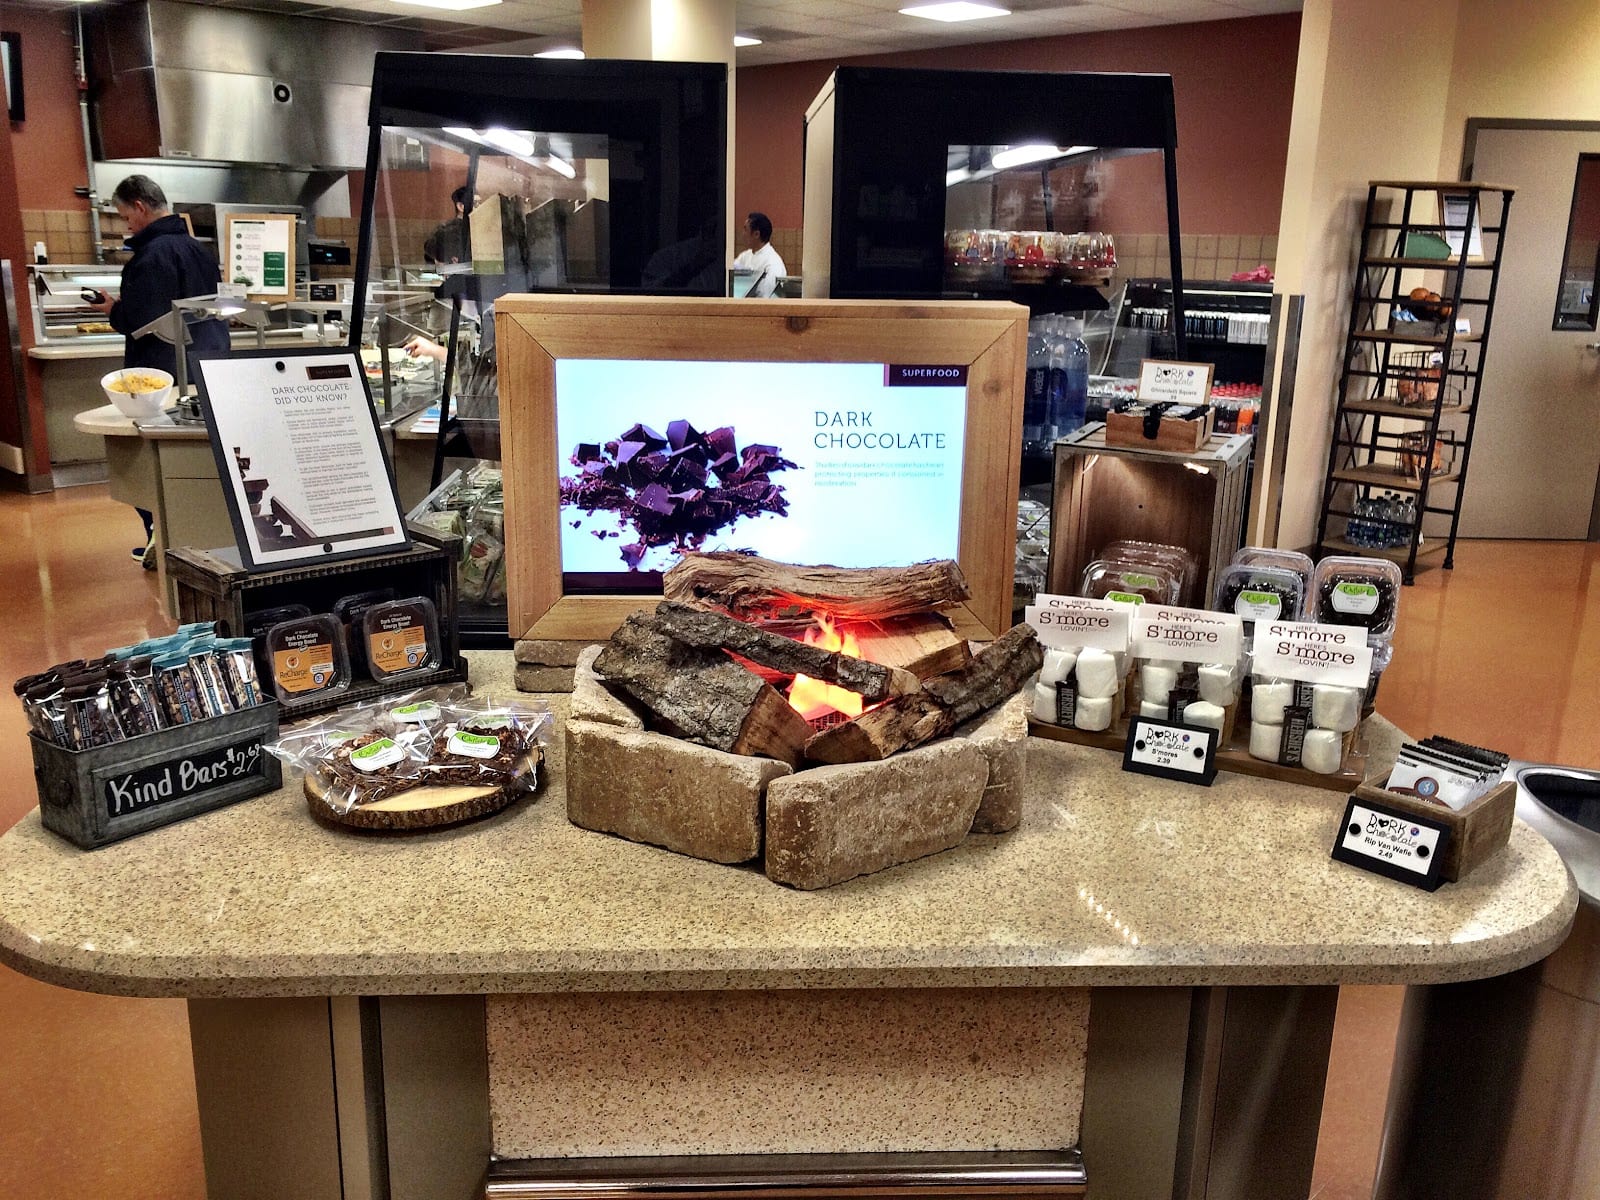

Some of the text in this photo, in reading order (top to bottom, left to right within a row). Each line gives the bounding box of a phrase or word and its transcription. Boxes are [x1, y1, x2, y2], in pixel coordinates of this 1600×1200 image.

[902, 368, 960, 377] SUPERFOOD
[272, 383, 350, 395] DARK CHOCOLATE
[274, 393, 348, 404] DID YOU KNOW?
[814, 411, 872, 427] DARK
[814, 432, 946, 449] CHOCOLATE
[1040, 612, 1110, 628] S'more
[1147, 624, 1218, 642] S'more
[376, 650, 403, 660] ReCharge
[1276, 642, 1355, 664] S'more
[280, 670, 308, 679] ReCharge
[1286, 718, 1305, 762] HERSHEY'S
[1152, 748, 1178, 758] S'mores
[109, 768, 173, 813] Kind
[178, 760, 228, 792] Bars
[1364, 836, 1376, 846] Rip
[1378, 840, 1391, 850] Van
[1378, 850, 1393, 859] 2.49
